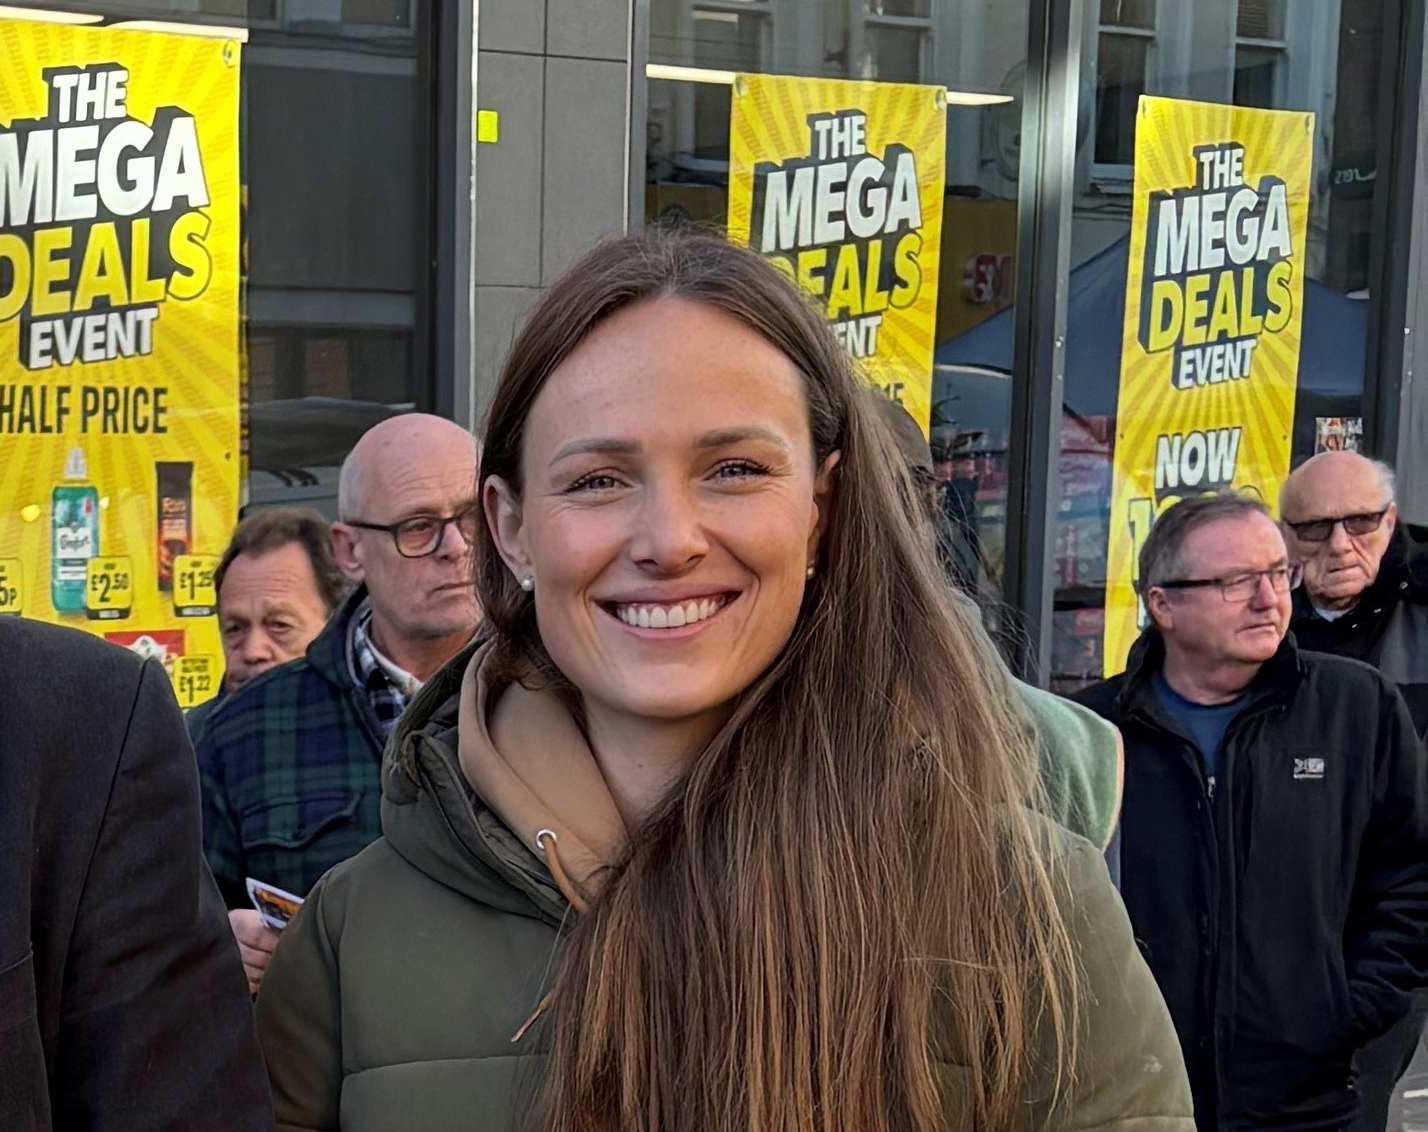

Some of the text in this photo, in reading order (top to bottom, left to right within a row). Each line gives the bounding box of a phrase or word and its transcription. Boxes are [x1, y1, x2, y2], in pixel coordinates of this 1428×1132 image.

[53, 69, 128, 123] THE
[815, 114, 866, 160] THE
[1199, 149, 1243, 190] THE
[761, 152, 922, 253] MEGA
[1154, 184, 1292, 276] MEGA
[1148, 260, 1293, 354] DEALS
[29, 306, 158, 370] EVENT
[1177, 338, 1258, 390] EVENT
[80, 385, 168, 435] PRICE
[1155, 427, 1241, 489] NOW
[90, 571, 130, 603] £2.50
